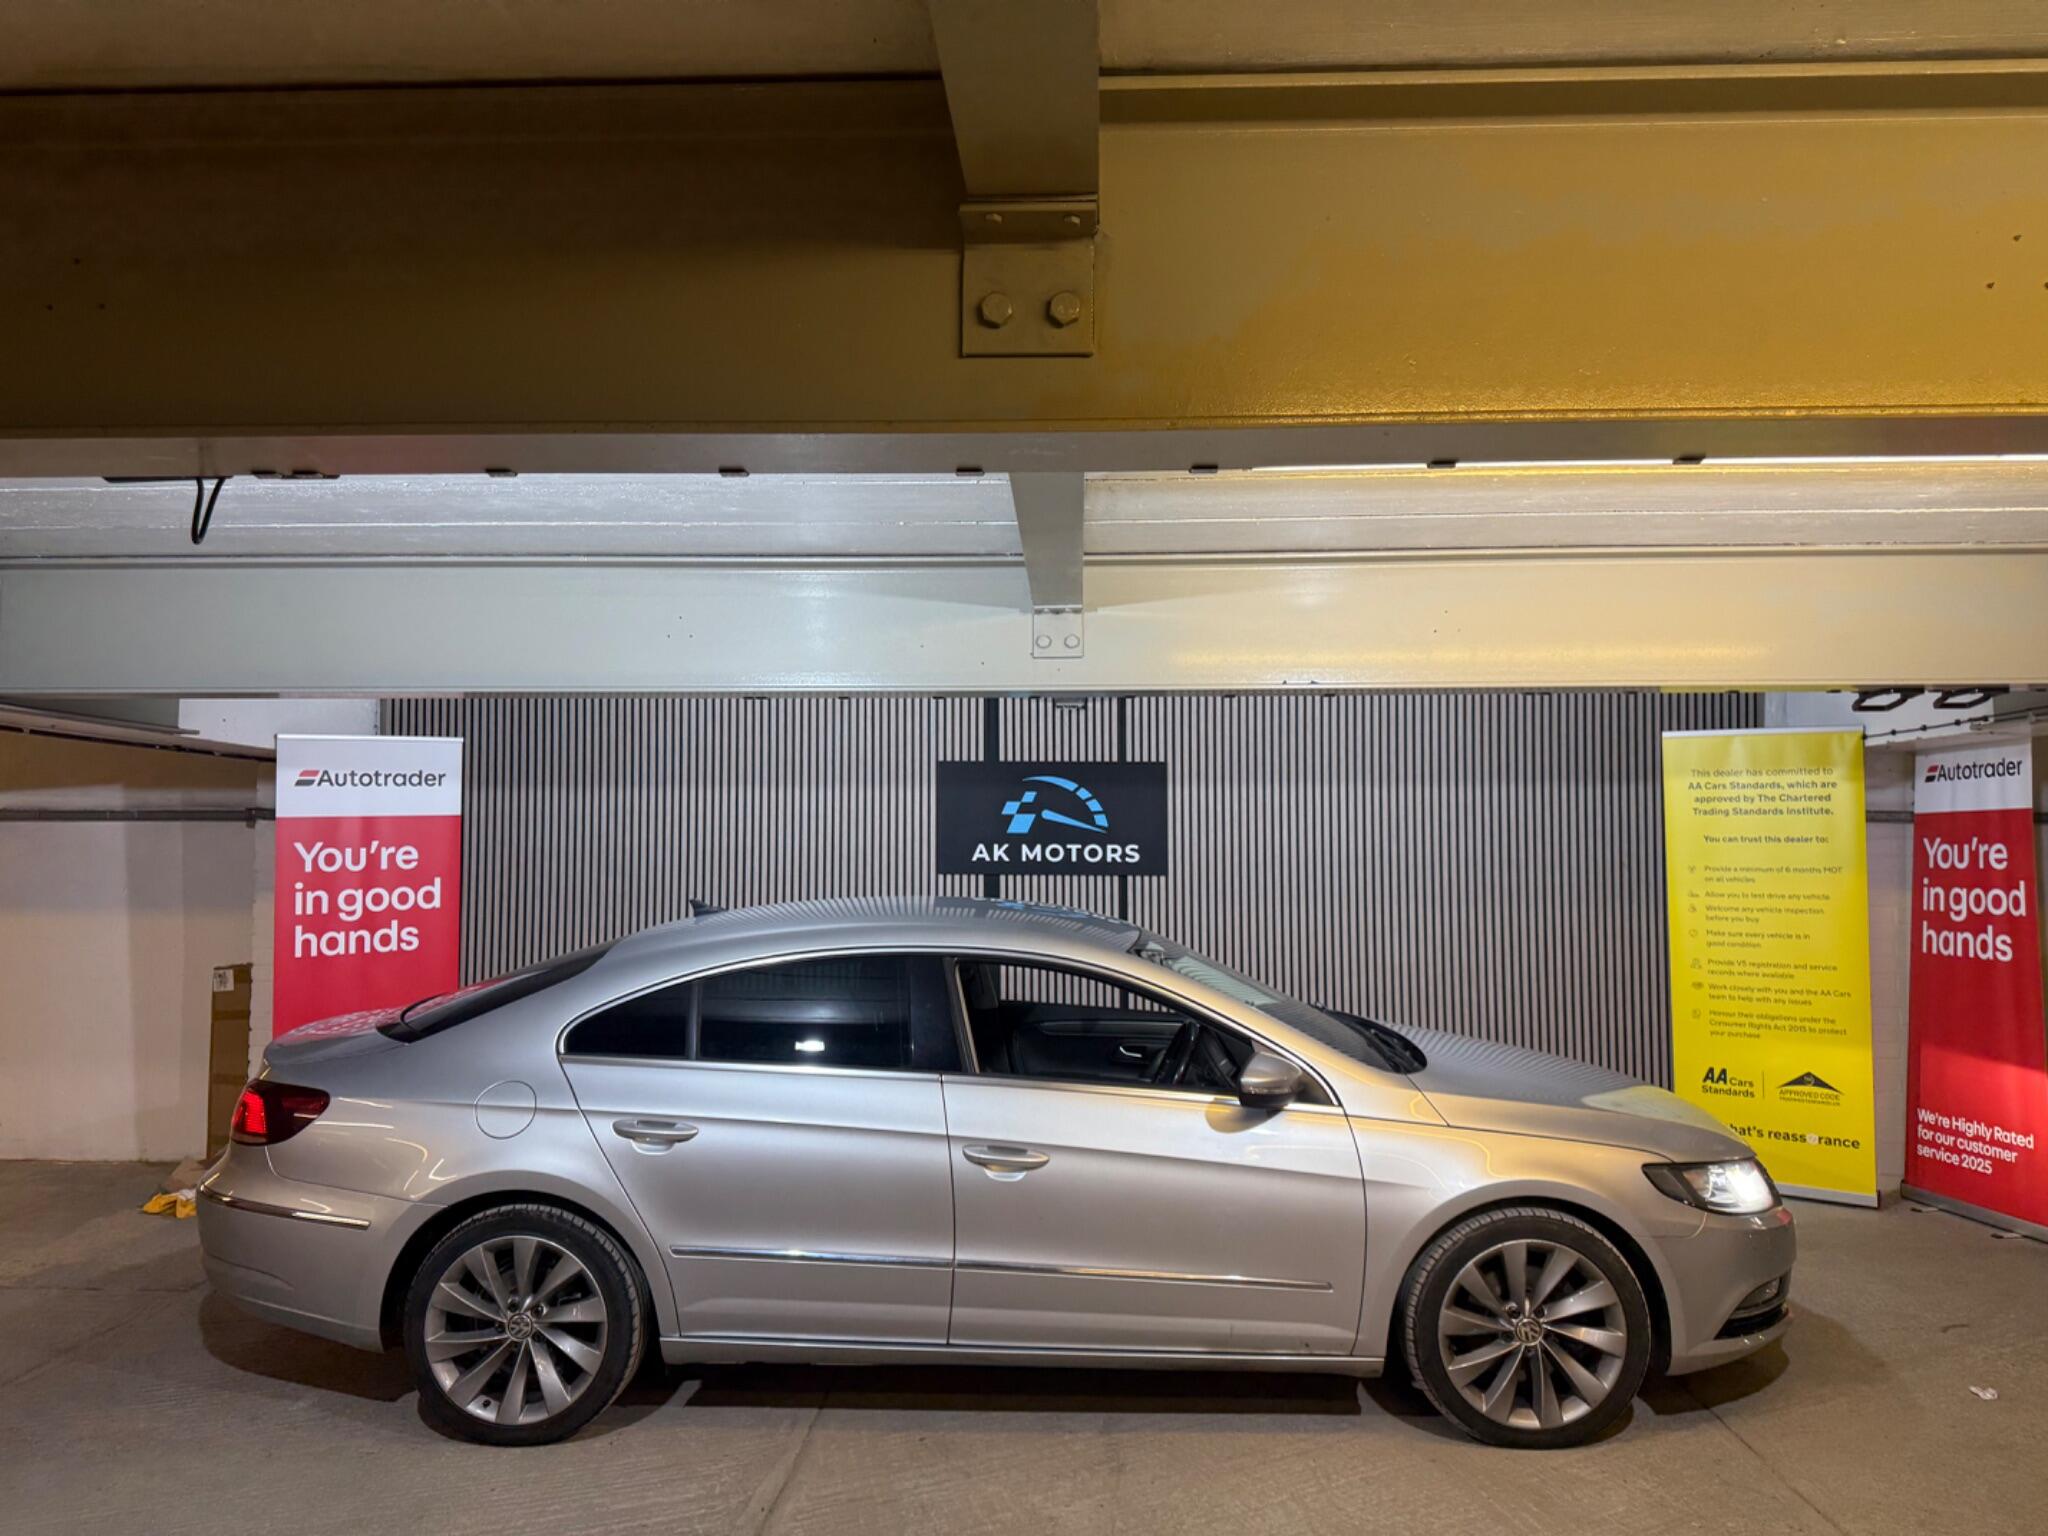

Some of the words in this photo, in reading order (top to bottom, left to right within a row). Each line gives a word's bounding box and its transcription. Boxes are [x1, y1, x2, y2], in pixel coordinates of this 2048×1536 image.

[317, 769, 446, 788] Autotrader
[1691, 769, 1711, 778] This
[1713, 768, 1743, 778] dealer
[1746, 768, 1763, 777] has
[1765, 767, 1821, 777] committed
[1822, 767, 1833, 776] to
[1936, 757, 2022, 782] Autotrader
[1688, 782, 1702, 791] AA
[1704, 782, 1727, 790] Cars
[1729, 781, 1785, 791] Standards,
[1786, 780, 1818, 789] which
[1820, 781, 1838, 789] are
[1694, 794, 1741, 804] approved
[1743, 794, 1755, 804] by
[1757, 794, 1776, 803] The
[1779, 793, 1832, 803] Chartered
[1693, 807, 1730, 817] Trading
[1732, 807, 1784, 816] Standards
[1786, 807, 1834, 816] Institute.
[1704, 835, 1720, 844] You
[1722, 836, 1739, 844] can
[1740, 835, 1762, 844] trust
[1764, 835, 1782, 844] this
[1784, 834, 1813, 844] dealer
[1815, 835, 1829, 844] to:
[293, 840, 419, 873] You're
[971, 843, 1010, 863] AK
[1021, 843, 1140, 863] MOTORS
[1922, 836, 2008, 871] You're
[294, 882, 329, 915] in
[337, 877, 441, 922] good
[1922, 877, 1944, 912] in
[1949, 880, 2026, 922] good
[294, 920, 419, 958] hands
[1922, 920, 2013, 962] hands
[1708, 983, 1727, 991] Work
[1729, 984, 1755, 994] closely
[1756, 985, 1772, 994] with
[1774, 988, 1788, 996] you
[1790, 987, 1804, 996] and
[1806, 988, 1818, 996] the
[1820, 989, 1831, 997] AA
[1833, 989, 1851, 998] Cars
[1702, 1066, 1728, 1085] AA
[1729, 1077, 1754, 1088] Cars
[1701, 1085, 1755, 1098] Standards
[1779, 1088, 1819, 1099] APPROVED
[1820, 1092, 1841, 1101] CODE
[1730, 1123, 1764, 1138] hat's
[1917, 1108, 1950, 1129] We're
[1952, 1116, 1993, 1142] Highly
[1994, 1126, 2035, 1150] Rated
[1917, 1126, 1934, 1141] for
[1936, 1132, 1956, 1147] our
[1957, 1136, 2019, 1163] customer
[1917, 1144, 1960, 1165] service
[1961, 1154, 1993, 1175] 2025
